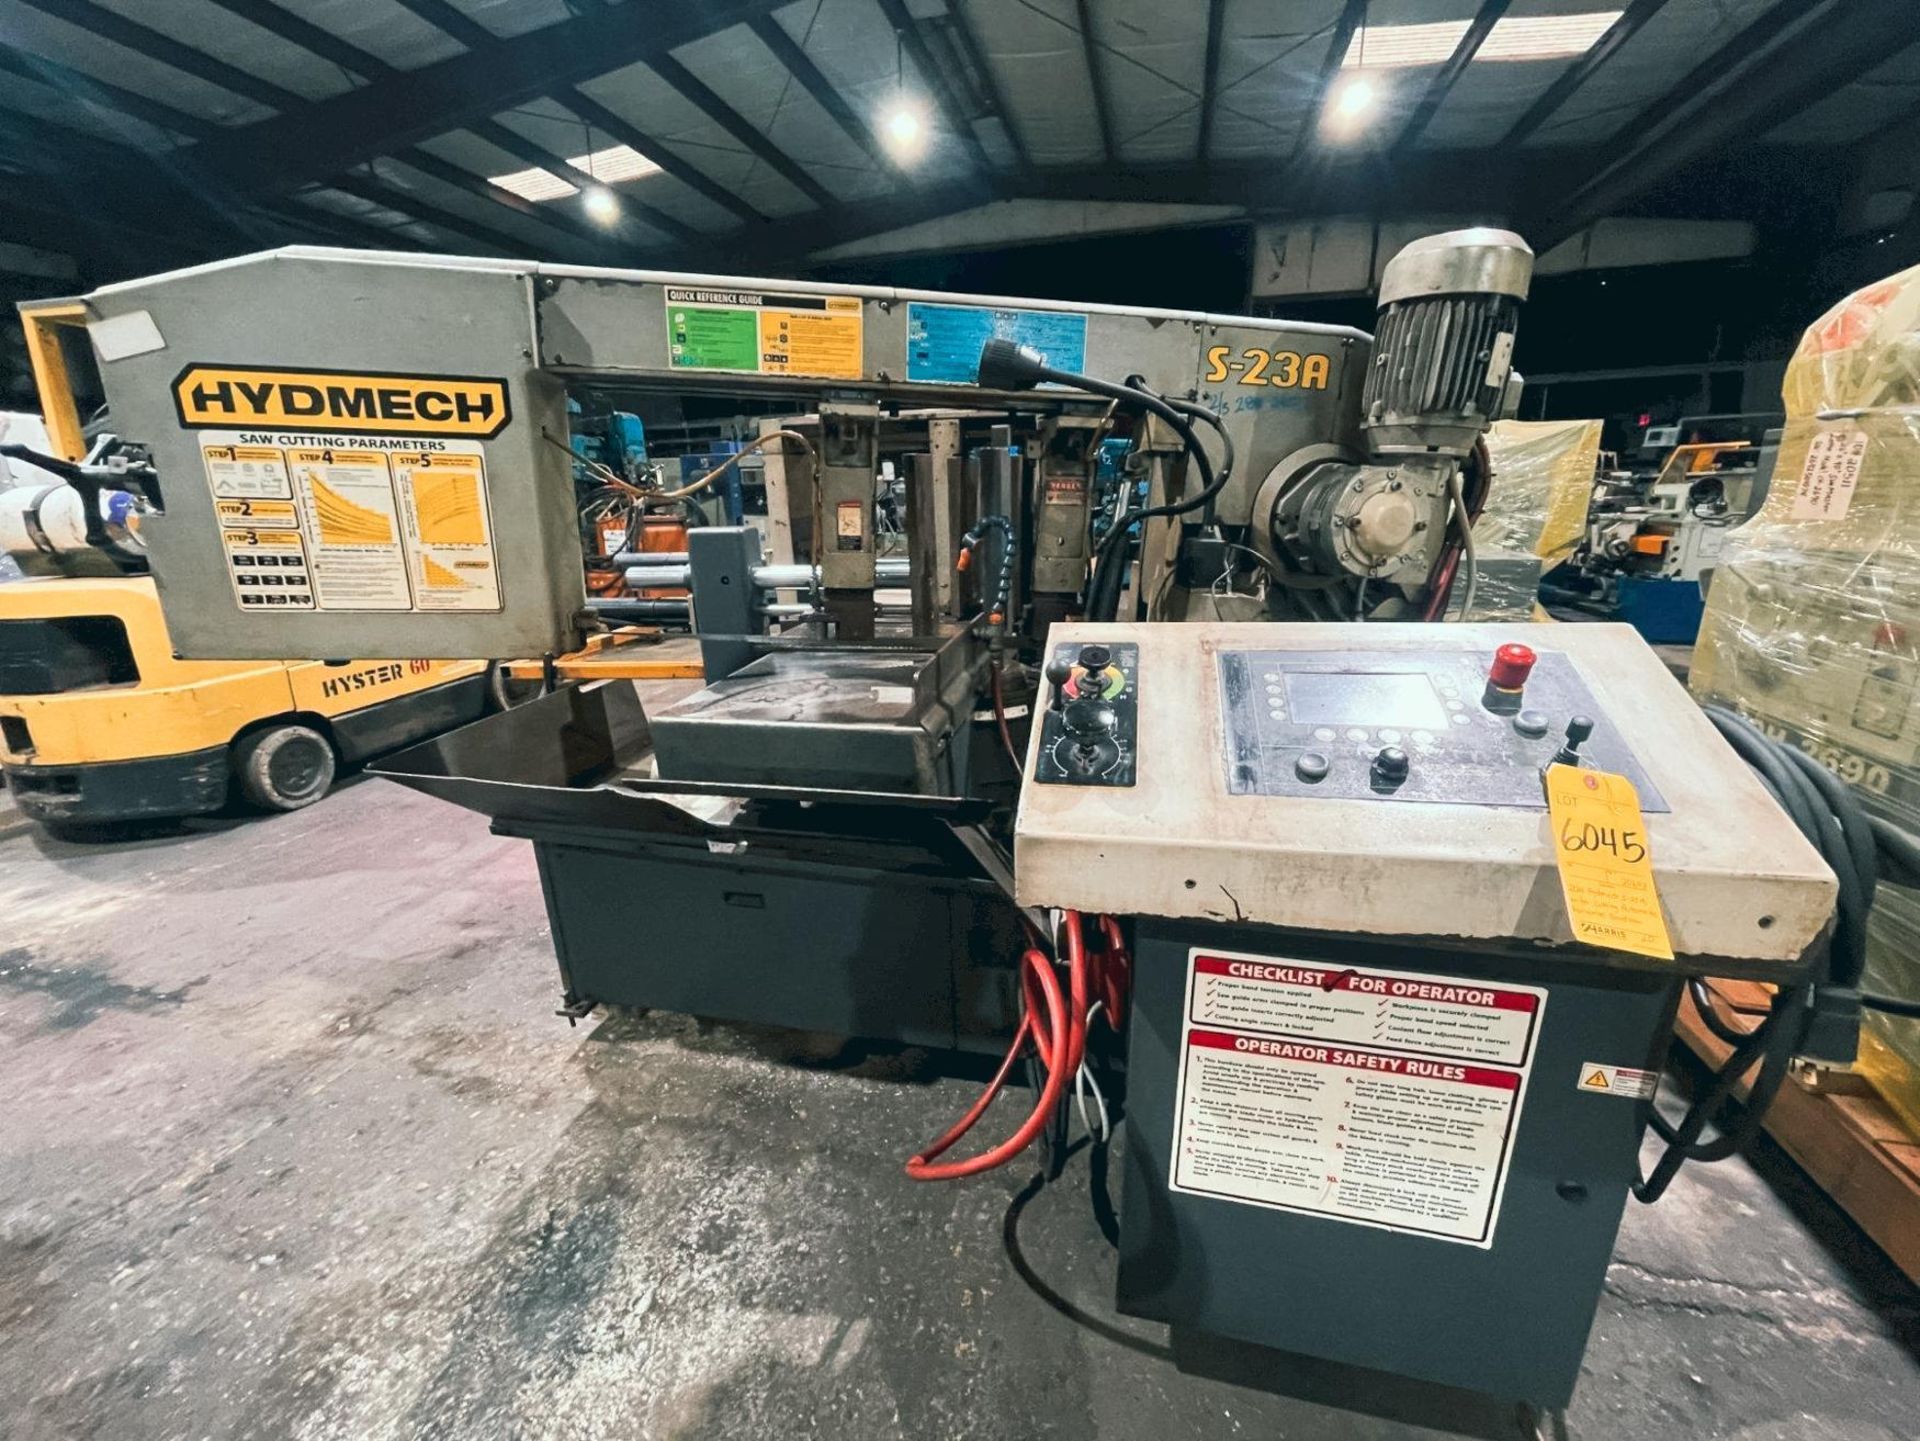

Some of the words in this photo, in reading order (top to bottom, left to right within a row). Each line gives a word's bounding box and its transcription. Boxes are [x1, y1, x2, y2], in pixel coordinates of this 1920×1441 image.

[670, 290, 695, 301] QUICK
[697, 292, 737, 304] REFERENCE
[738, 295, 763, 305] GUIDE
[1205, 346, 1330, 389] S-23A
[191, 381, 492, 422] HYDMECH
[240, 433, 273, 444] SAW
[278, 435, 345, 447] CUTTING
[349, 437, 446, 451] PARAMETERS
[207, 450, 228, 458] STEP
[299, 453, 320, 461] STEP
[321, 450, 334, 464] 4
[399, 457, 420, 465] STEP
[220, 505, 242, 513] STEP
[322, 663, 403, 698] HYSTER
[410, 658, 430, 675] 60
[1556, 794, 1578, 808] LOT
[1561, 817, 1646, 864] 6045
[1217, 981, 1238, 989] Proper
[1228, 962, 1326, 986] CHECKLIST
[1348, 976, 1386, 993] FOR
[1391, 982, 1495, 1006] OPERATOR
[1232, 993, 1249, 1001] guide
[1231, 1004, 1248, 1012] guide
[1389, 1013, 1412, 1022] Proper
[1235, 1037, 1328, 1063] OPERATOR
[1331, 1050, 1400, 1073] SAFETY
[1405, 1062, 1466, 1081] RULES
